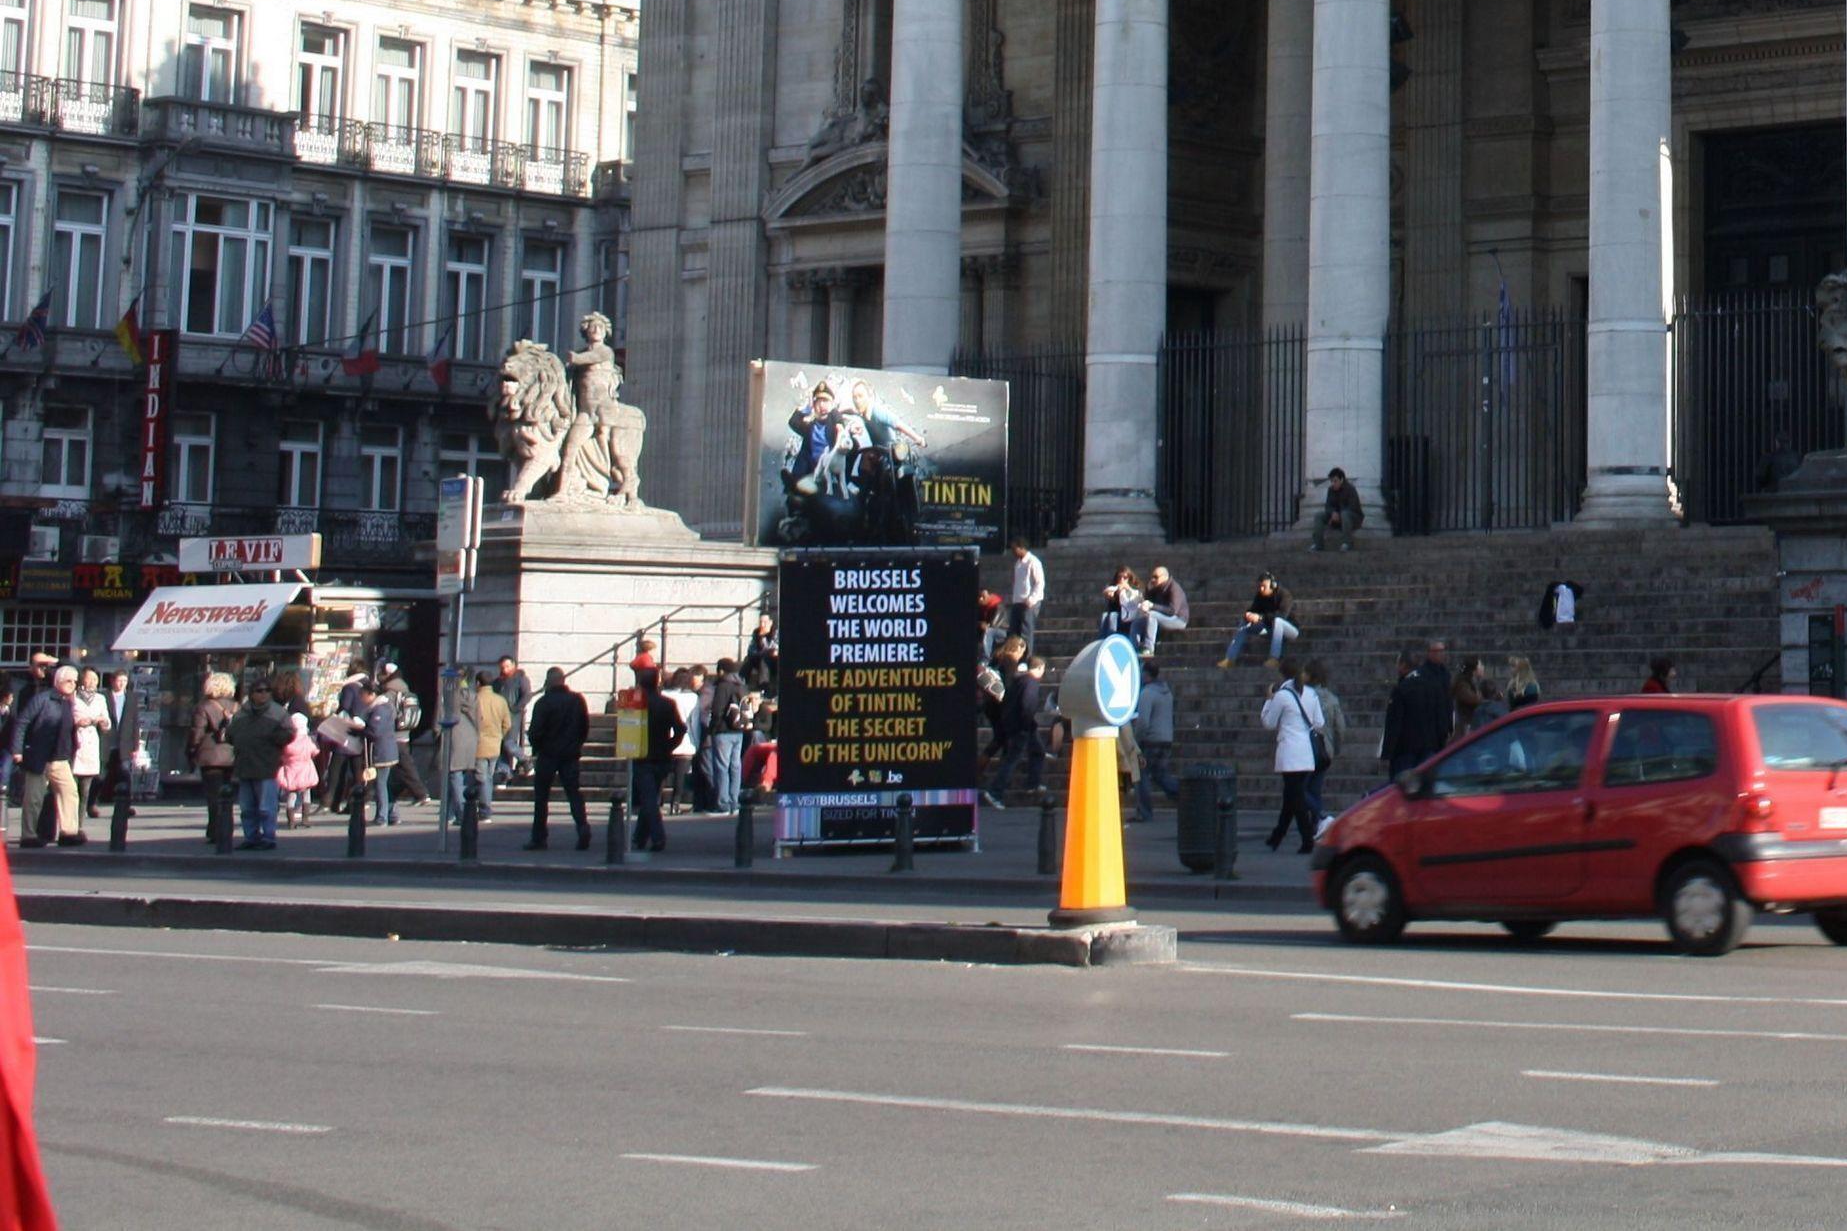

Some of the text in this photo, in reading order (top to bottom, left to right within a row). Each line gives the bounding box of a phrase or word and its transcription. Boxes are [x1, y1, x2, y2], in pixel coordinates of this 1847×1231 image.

[142, 334, 161, 506] INDIAN
[921, 480, 992, 506] TINTIN
[209, 538, 283, 563] LE VIF
[834, 569, 922, 589] BRUSSELS
[93, 588, 134, 599] INDIAN
[144, 599, 269, 625] Newsweek
[829, 594, 925, 614] WELCOMES
[826, 618, 928, 638] THE WORLD
[830, 643, 925, 663] PREMIERE:
[842, 667, 957, 688] ADVENTURES
[831, 692, 923, 713] OF TINTIN:
[826, 717, 927, 738] THE SECRET
[800, 744, 823, 763] OF
[826, 743, 860, 763] THE
[856, 808, 879, 819] FOR
